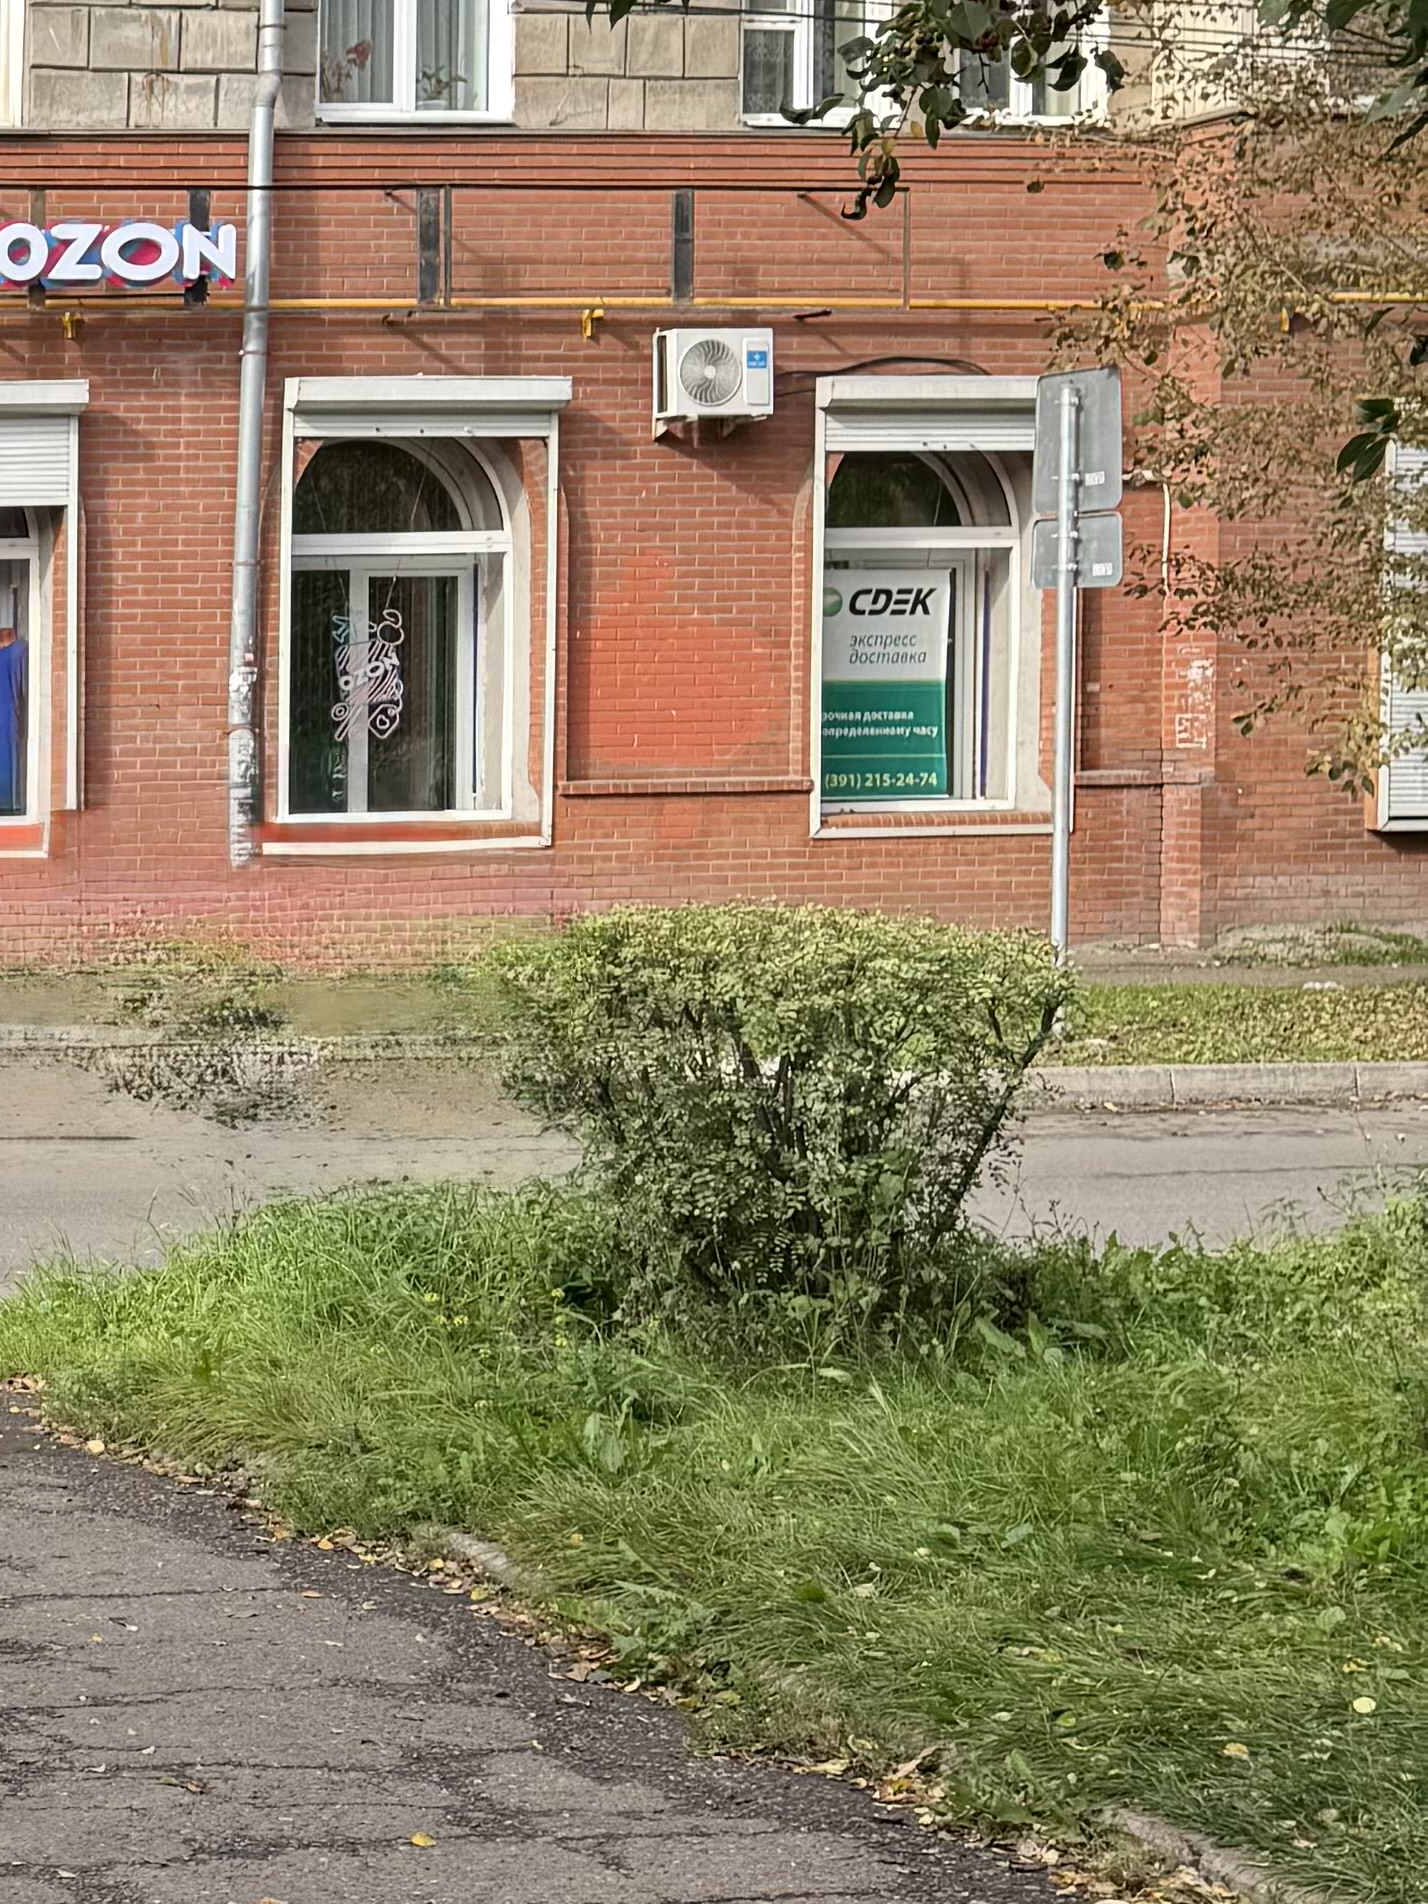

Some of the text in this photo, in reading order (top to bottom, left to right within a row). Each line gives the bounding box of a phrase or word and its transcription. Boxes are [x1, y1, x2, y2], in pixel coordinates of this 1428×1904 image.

[849, 587, 937, 616] CDEK
[849, 633, 918, 650] экспресс
[849, 648, 927, 665] доставка
[338, 652, 400, 691] OZON
[863, 711, 914, 723] доставка
[913, 726, 938, 739] часу
[825, 771, 937, 790] (391) 215-24-74
